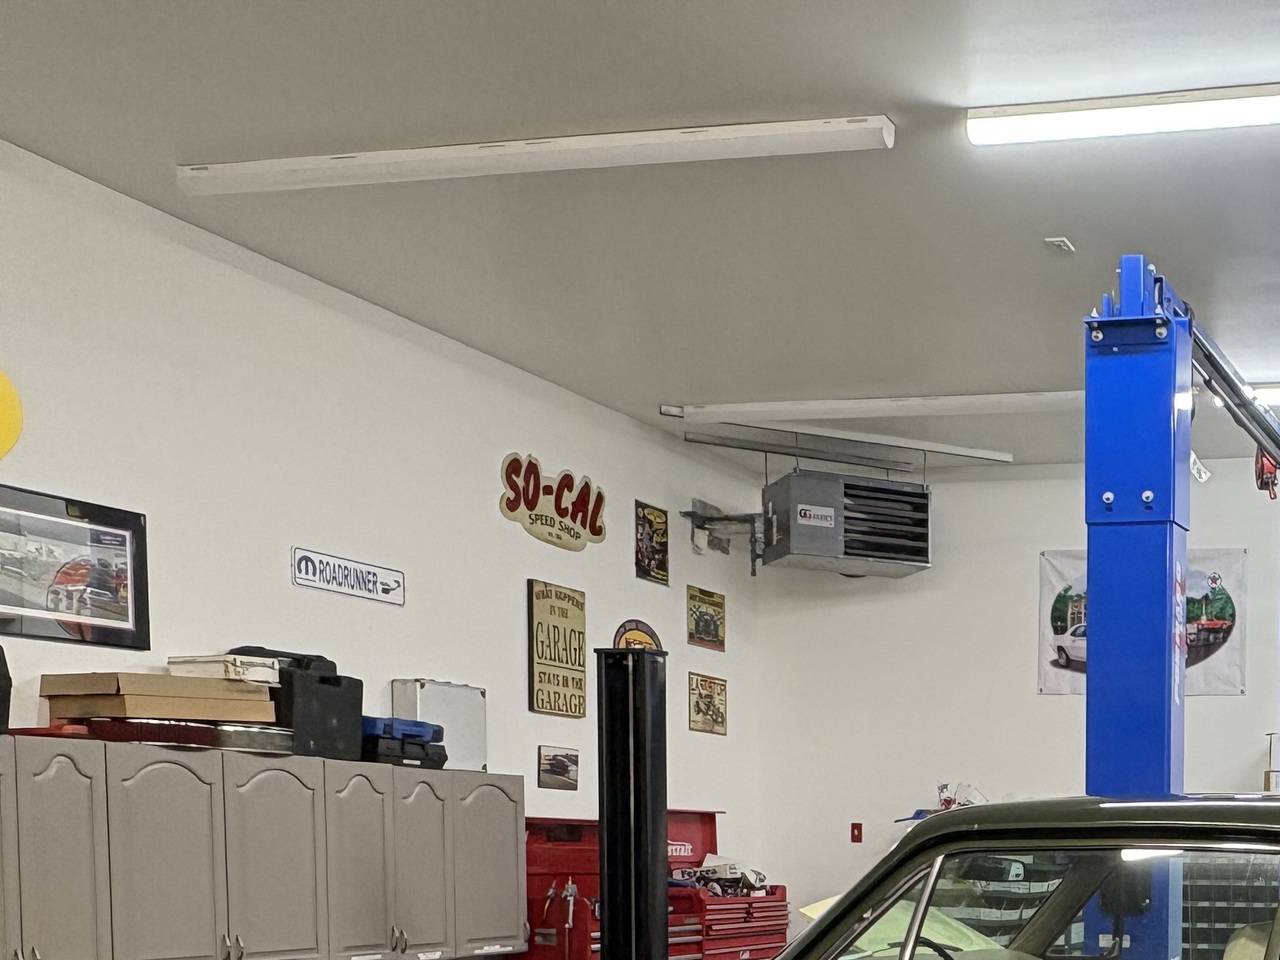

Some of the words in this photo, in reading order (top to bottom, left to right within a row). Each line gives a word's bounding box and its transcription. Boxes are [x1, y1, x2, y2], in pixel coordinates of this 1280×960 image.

[505, 457, 604, 537] SO-CAL
[528, 513, 556, 528] SPEED
[558, 520, 582, 541] SHOP
[318, 559, 379, 595] ROADRUNNER
[535, 621, 585, 668] GARAGE
[535, 688, 585, 716] GARAGE
